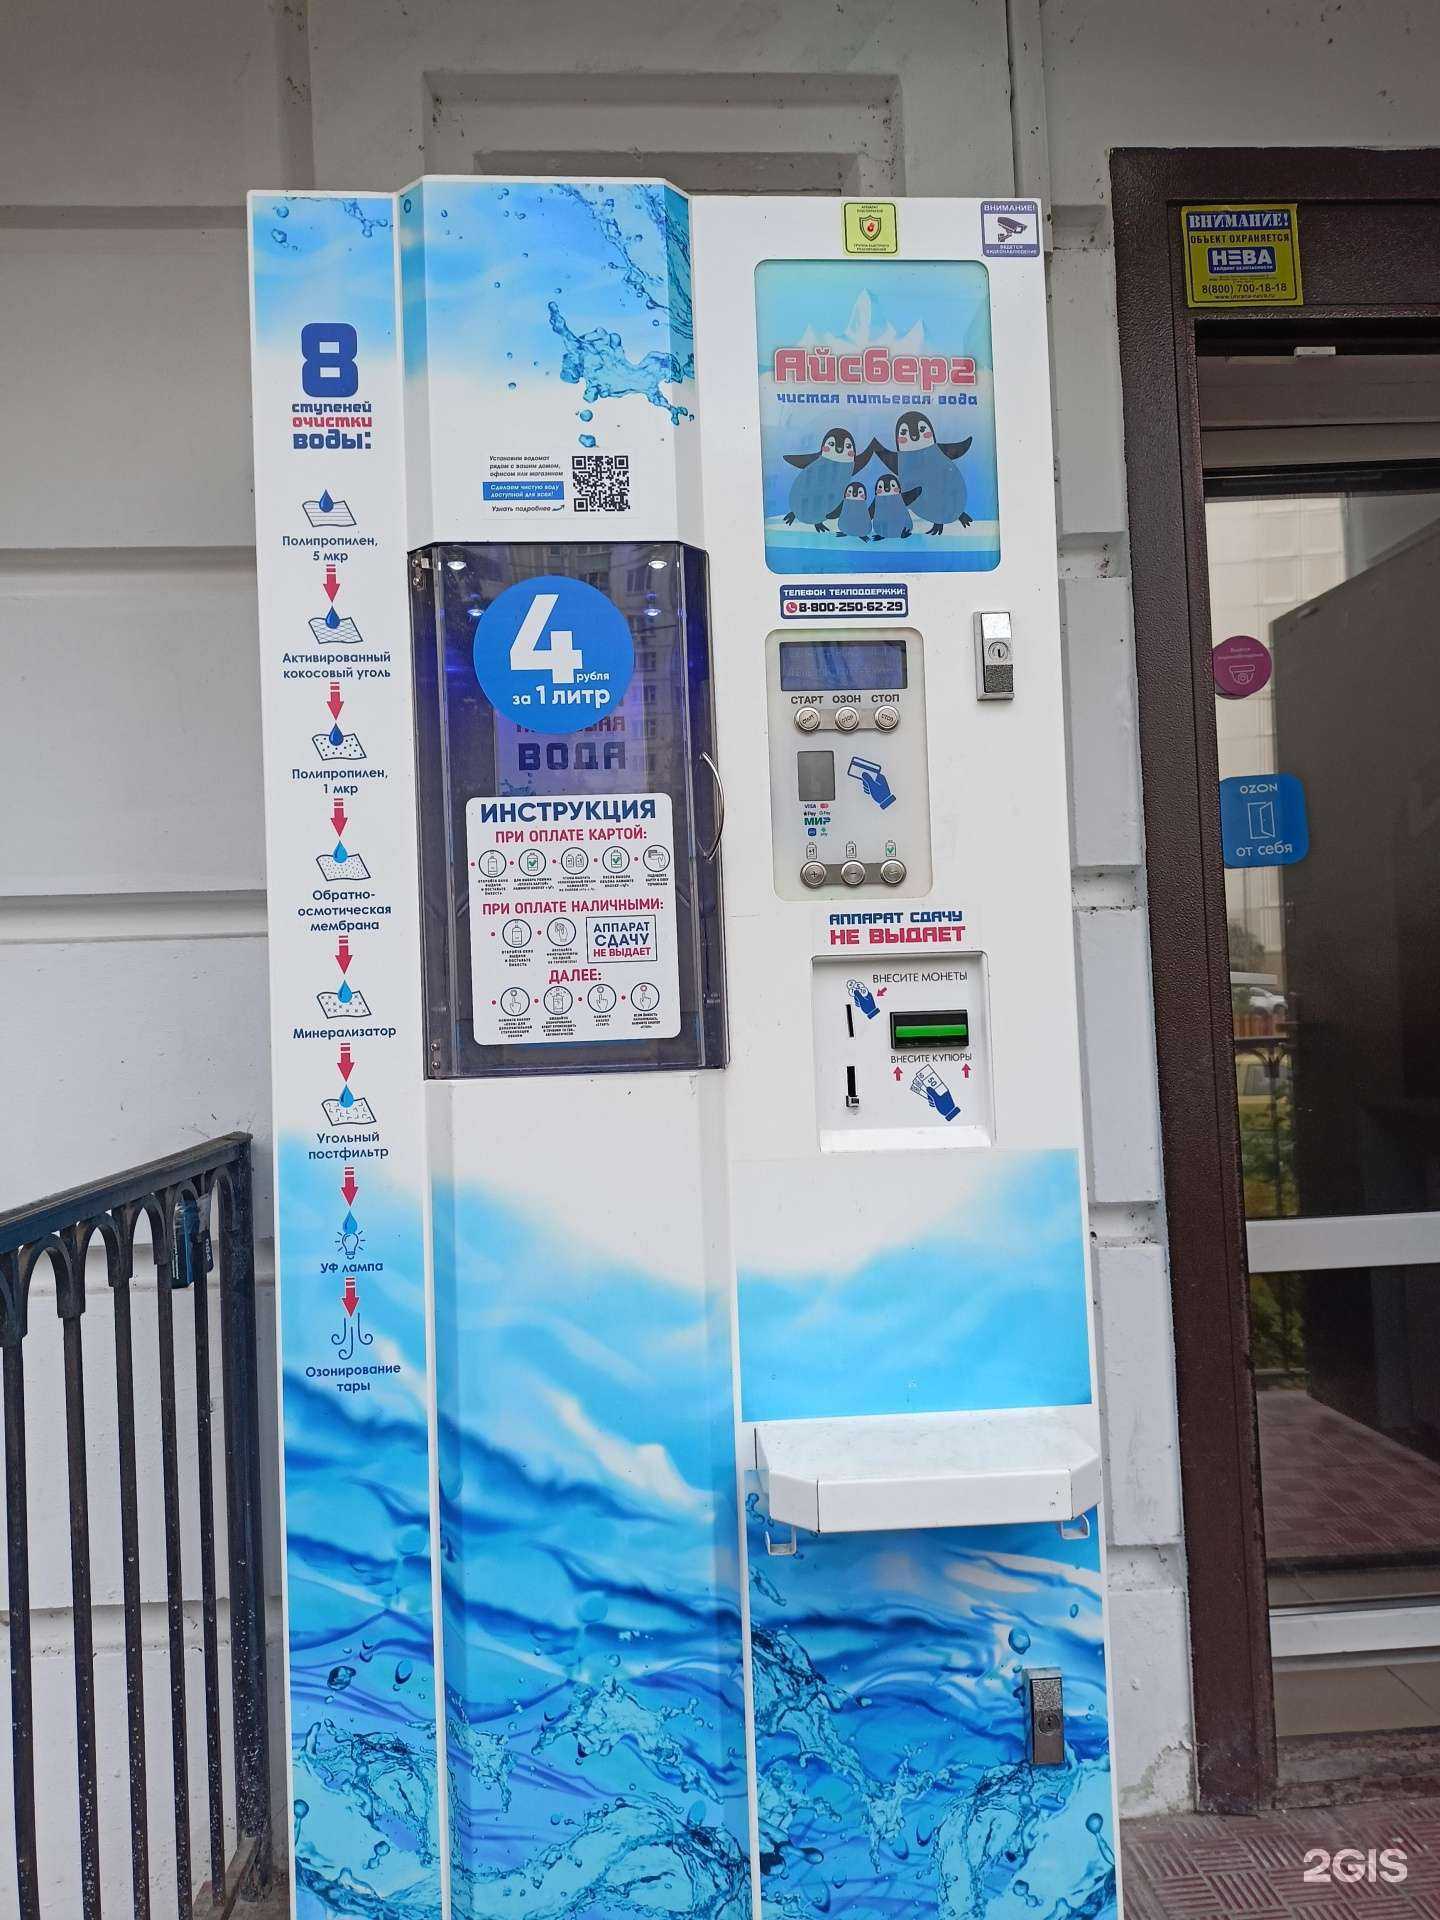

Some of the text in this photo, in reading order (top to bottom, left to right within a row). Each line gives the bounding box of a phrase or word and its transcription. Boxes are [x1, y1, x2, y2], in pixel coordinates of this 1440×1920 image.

[984, 204, 1035, 212] ВНИМАНИЕ!
[1188, 213, 1289, 228] ВНИМАНИЕ!
[1191, 234, 1290, 244] ОБЪЕКТ ОХРАНЯЕТСЯ
[1202, 282, 1287, 295] 8(800) 700-18-18
[301, 322, 358, 398] 8
[774, 346, 976, 392] Айсберг
[777, 392, 978, 405] чистая питьевая вода
[292, 401, 372, 415] ступеней
[292, 416, 372, 428] очистки
[293, 429, 371, 450] воды:
[282, 536, 378, 548] Полипропилен,
[312, 550, 348, 563] 5 мкр
[784, 588, 906, 597] ТЕЛЕФОН ТЕХПОДДЕРЖКИ:
[798, 602, 903, 612] 8-800-250-62-29
[510, 593, 583, 684] 4
[282, 652, 391, 664] Активированный
[284, 668, 391, 680] кокосовый уголь
[576, 671, 610, 684] рубля
[512, 686, 611, 708] за 1 литр
[790, 696, 824, 704] СТАРТ
[832, 694, 861, 703] ОЗОН
[871, 694, 900, 703] СТОП
[518, 741, 626, 770] ВОДА
[292, 768, 388, 780] Полипропилен,
[324, 784, 358, 796] 1 мкр
[1240, 783, 1278, 794] OZON
[480, 799, 656, 823] ИНСТРУКЦИЯ
[804, 816, 831, 826] МИР
[495, 824, 647, 843] ПРИ ОПЛАТЕ КАРТОЙ:
[312, 890, 376, 902] Обратно-
[298, 906, 392, 916] осмотическая
[482, 898, 664, 915] ПРИ ОПЛАТЕ НАЛИЧНЫМИ:
[829, 910, 963, 925] АППАРАТ СДАЧУ
[310, 920, 380, 932] мембрана
[593, 922, 650, 933] АППАРАТ
[594, 934, 650, 948] СДАЧУ
[830, 926, 966, 945] НЕ ВЫДАЕТ
[593, 947, 652, 958] НЕ ВЫДАЕТ
[549, 968, 602, 984] ДАЛЕЕ:
[872, 972, 968, 984] ВНЕСИТЕ МОНЕТЫ
[292, 1027, 396, 1040] Минерализатор
[890, 1053, 972, 1064] ВНЕСИТЕ КУПЮРЫ
[927, 1076, 938, 1087] 50
[316, 1131, 380, 1144] Угольный
[308, 1147, 389, 1160] постфильтр
[342, 1262, 384, 1274] лампа
[305, 1364, 401, 1378] Озонирование
[336, 1381, 370, 1393] тары
